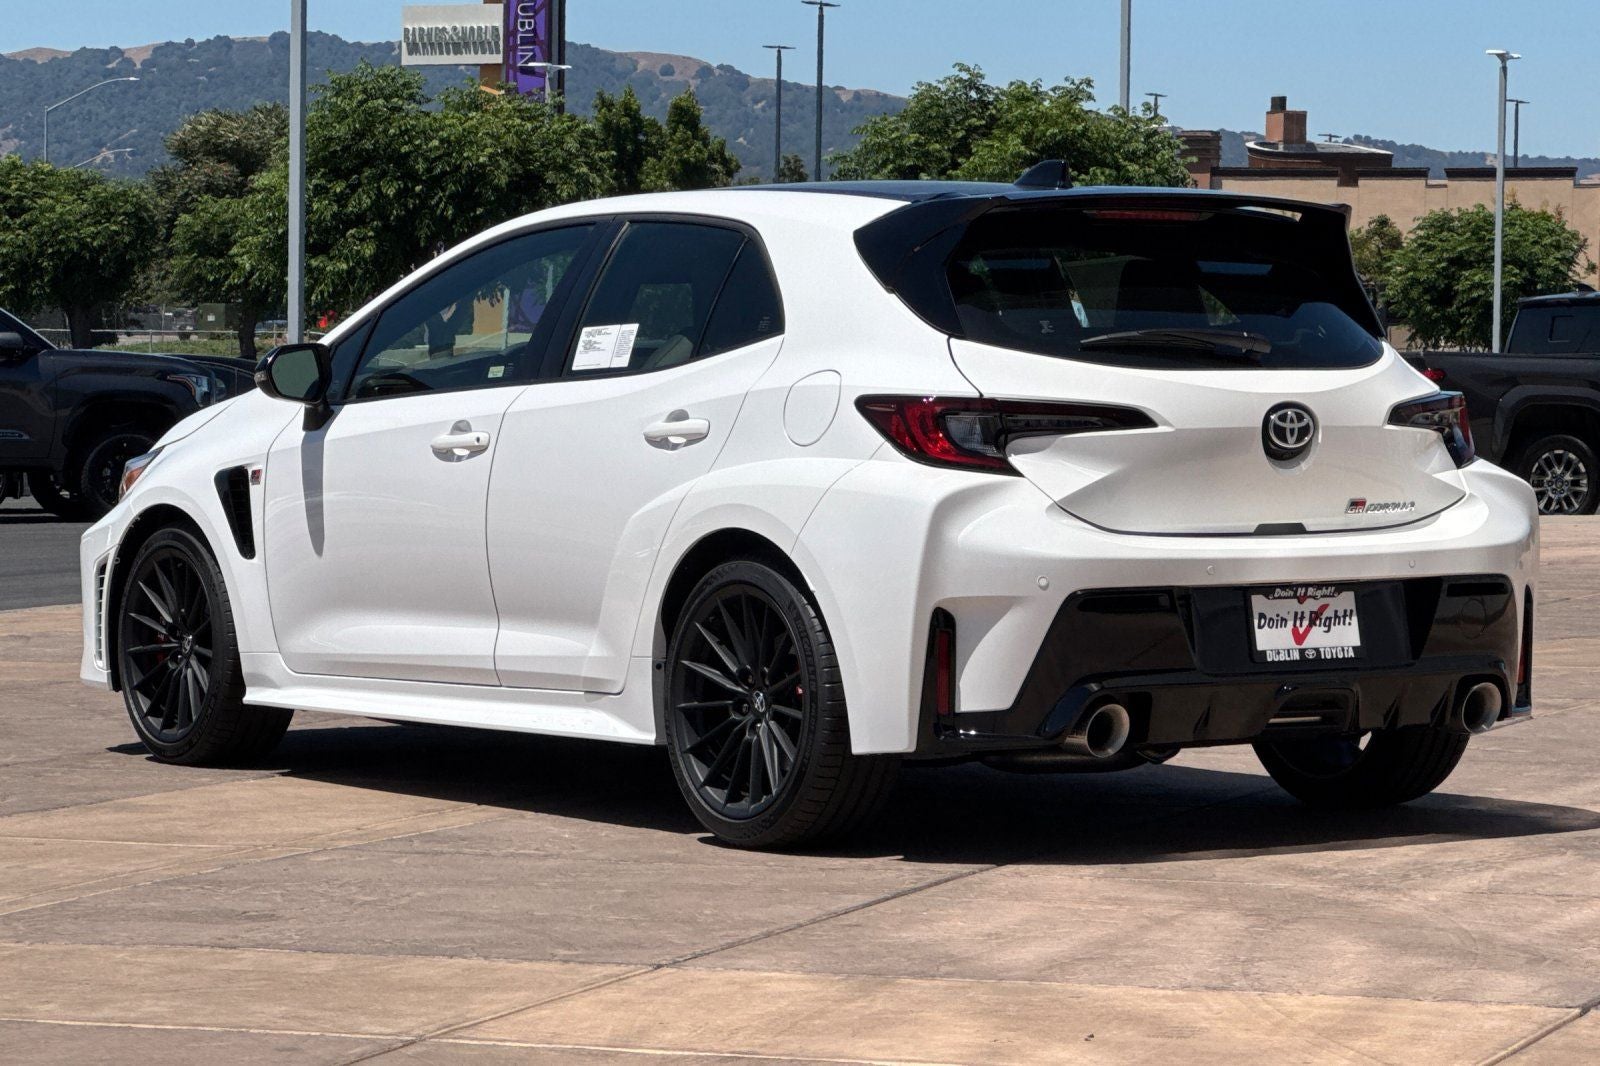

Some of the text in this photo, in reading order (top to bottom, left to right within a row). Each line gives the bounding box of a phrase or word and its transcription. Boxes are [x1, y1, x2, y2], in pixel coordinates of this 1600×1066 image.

[517, 0, 535, 67] UBLIN
[1297, 587, 1306, 597] It
[1307, 586, 1336, 599] Right!
[1257, 609, 1354, 633] Doin' It Right!
[1266, 647, 1355, 662] DUBLIN TOYOTA
